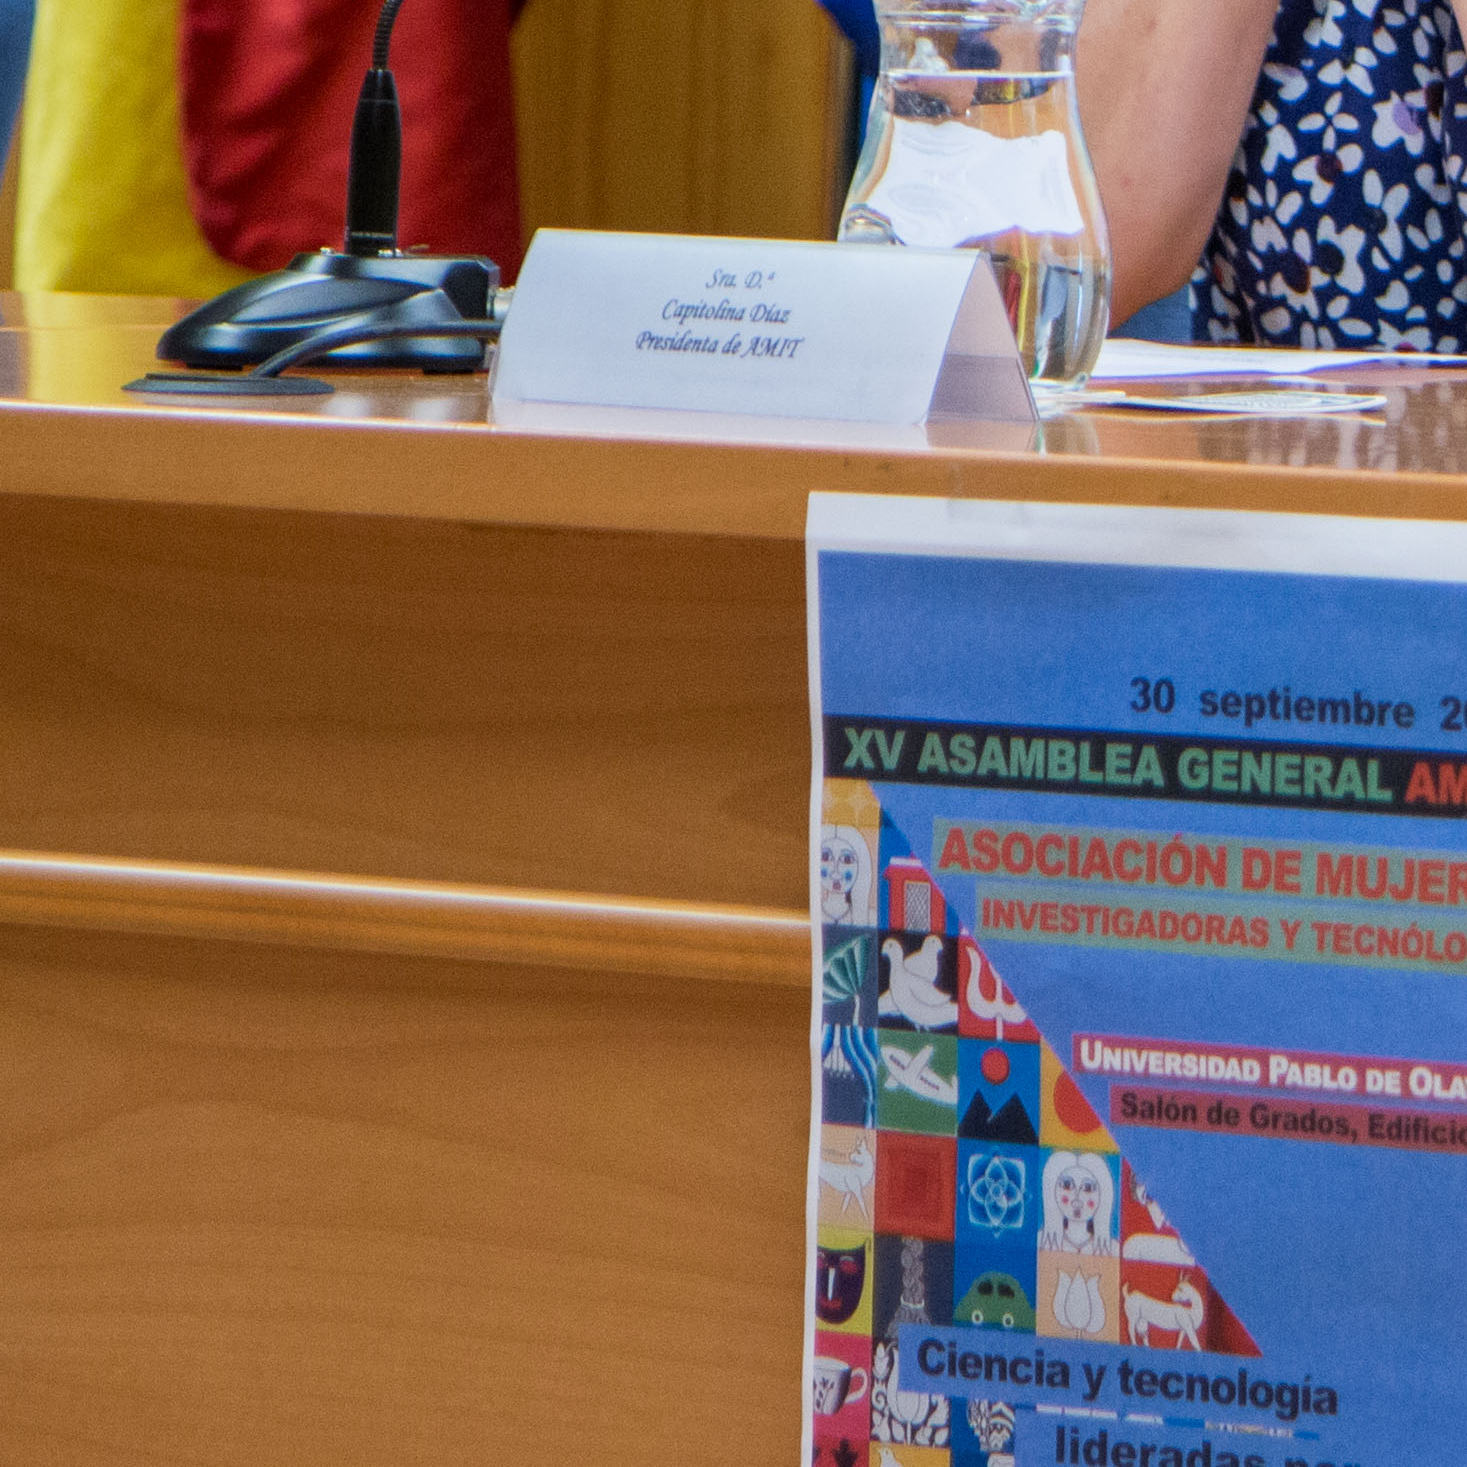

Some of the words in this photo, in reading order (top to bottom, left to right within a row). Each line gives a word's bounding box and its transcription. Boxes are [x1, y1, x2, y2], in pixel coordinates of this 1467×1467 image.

[661, 299, 746, 327] Capitolina
[748, 301, 792, 324] Díaz
[635, 331, 718, 355] Presidenta
[721, 332, 742, 356] de
[742, 335, 805, 359] AMIT
[1130, 676, 1176, 714] 30
[1199, 686, 1416, 730] septiembre
[843, 727, 905, 771] XV
[917, 733, 1166, 788] ASAMBLEA
[1178, 749, 1393, 802] GENERAL
[938, 826, 1228, 889] ASOCIACIÓN
[1241, 848, 1304, 894] DE
[981, 897, 1271, 949] INVESTIGADORAS
[1281, 919, 1301, 950] Y
[1080, 1037, 1262, 1083] UNIVERSIDAD
[1268, 1052, 1358, 1090] PABLO
[1366, 1067, 1400, 1094] DE
[1120, 1092, 1198, 1125] Salón
[1205, 1100, 1241, 1129] de
[1249, 1104, 1358, 1142] Grados,
[917, 1340, 1071, 1390] Ciencia
[1081, 1363, 1107, 1402] y
[1117, 1357, 1338, 1422] tecnología
